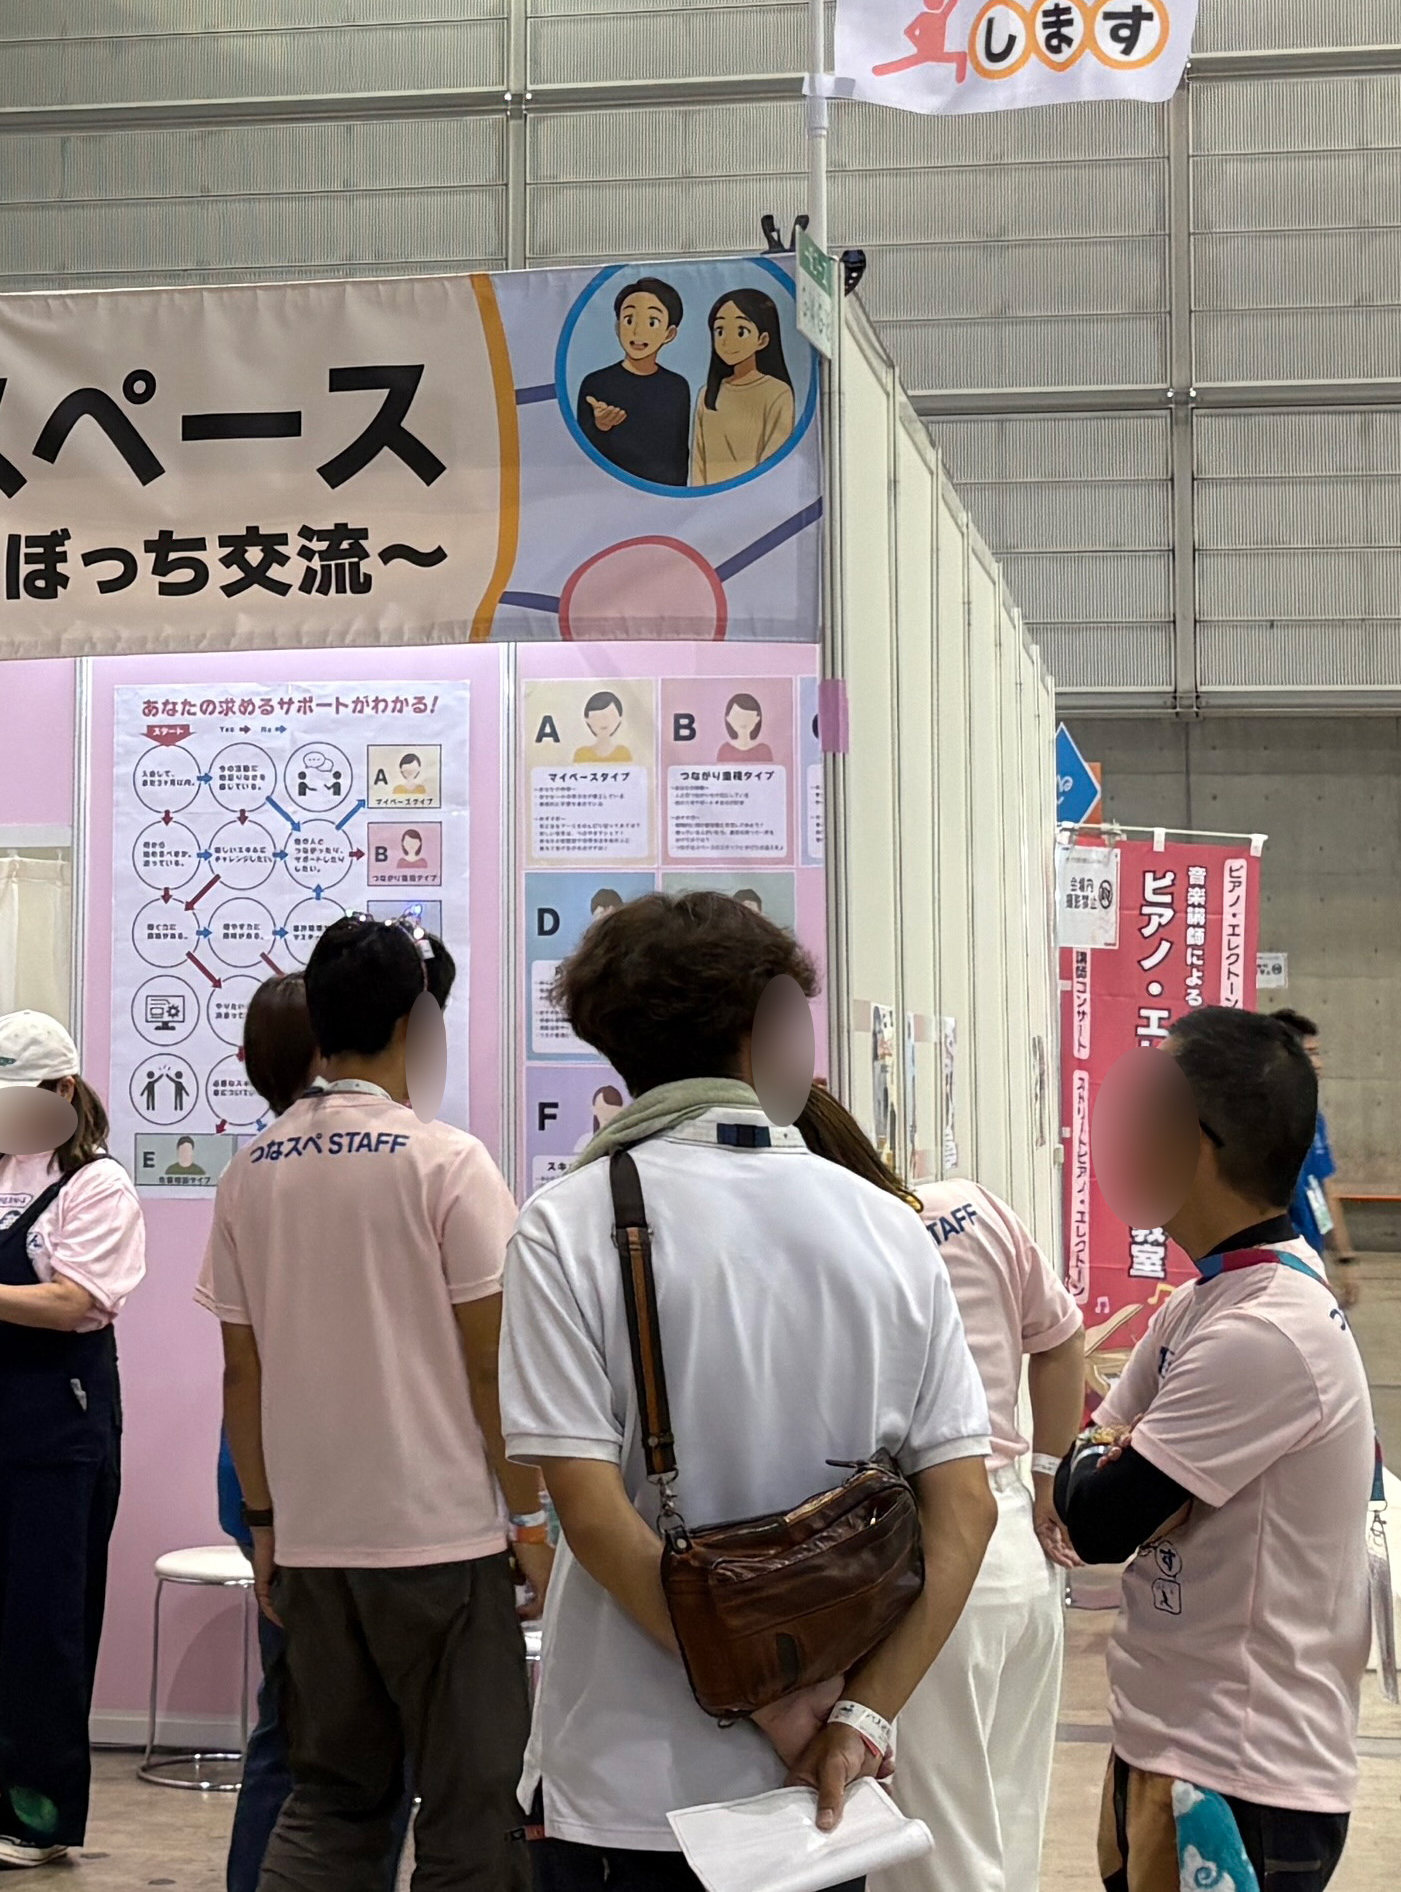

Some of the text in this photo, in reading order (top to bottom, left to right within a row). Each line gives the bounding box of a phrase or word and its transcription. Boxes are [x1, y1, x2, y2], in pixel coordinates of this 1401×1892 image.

[985, 2, 1154, 64] します
[152, 727, 185, 736] スタート
[534, 715, 561, 744] A
[673, 713, 697, 742] B
[374, 768, 389, 786] A
[548, 772, 631, 783] マイペースタイプ
[376, 798, 433, 806] マイペースタイプ
[375, 846, 389, 862] B
[537, 908, 560, 936] D
[1135, 870, 1178, 1046] ピアノ・エ
[537, 1102, 560, 1131] F
[142, 1151, 156, 1168] E
[250, 1131, 411, 1164] つなスペ STAFF
[926, 1202, 978, 1246] TAFF
